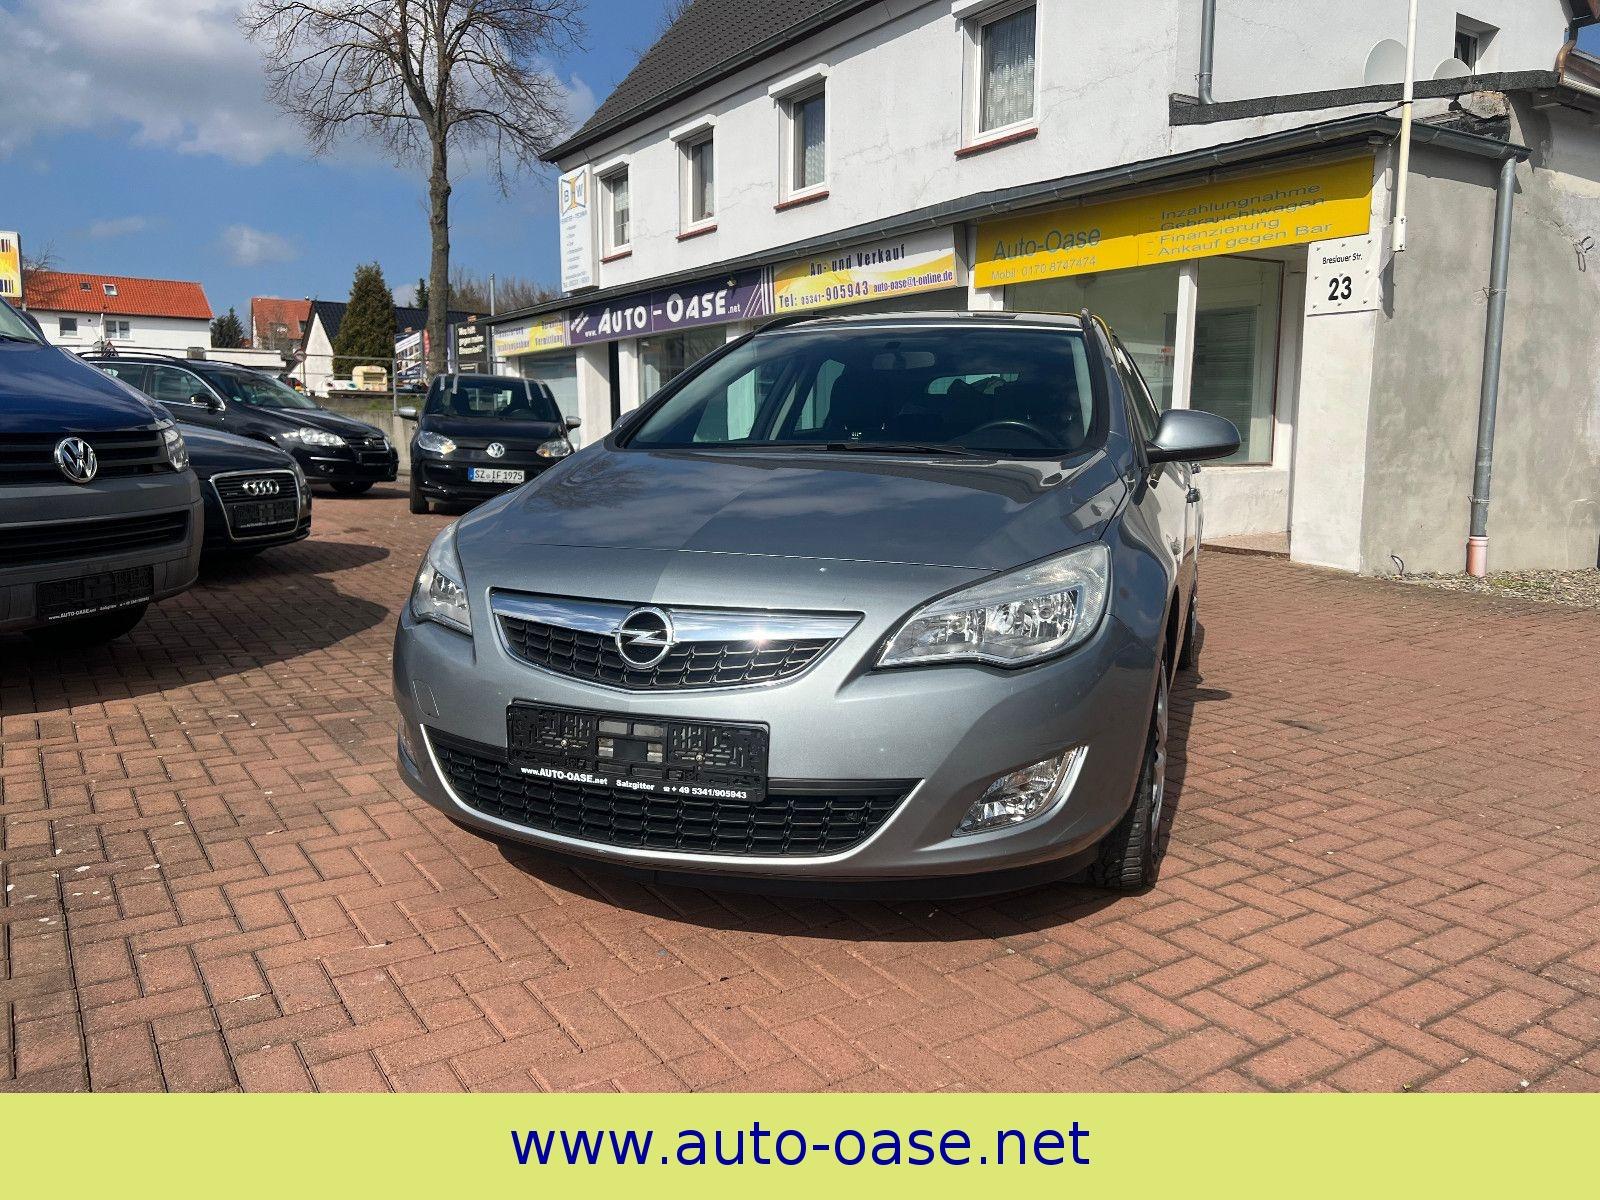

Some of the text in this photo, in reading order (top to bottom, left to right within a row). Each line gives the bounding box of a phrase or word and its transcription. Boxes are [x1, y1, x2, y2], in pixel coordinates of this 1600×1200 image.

[1162, 184, 1321, 220] Inzahlungnahme
[992, 228, 1101, 261] Auto-Oase
[1158, 223, 1333, 257] Ankauf gegen Bar
[1160, 218, 1280, 244] Finanzierung
[832, 254, 852, 272] und
[857, 243, 905, 267] Verkauf
[1322, 252, 1363, 265] Breslauer Str.
[1328, 276, 1352, 301] 23
[503, 471, 523, 481] 1975
[520, 767, 608, 785] www.AUTO-OASE.net
[616, 779, 655, 791] Salzgitter
[678, 786, 690, 794] 49
